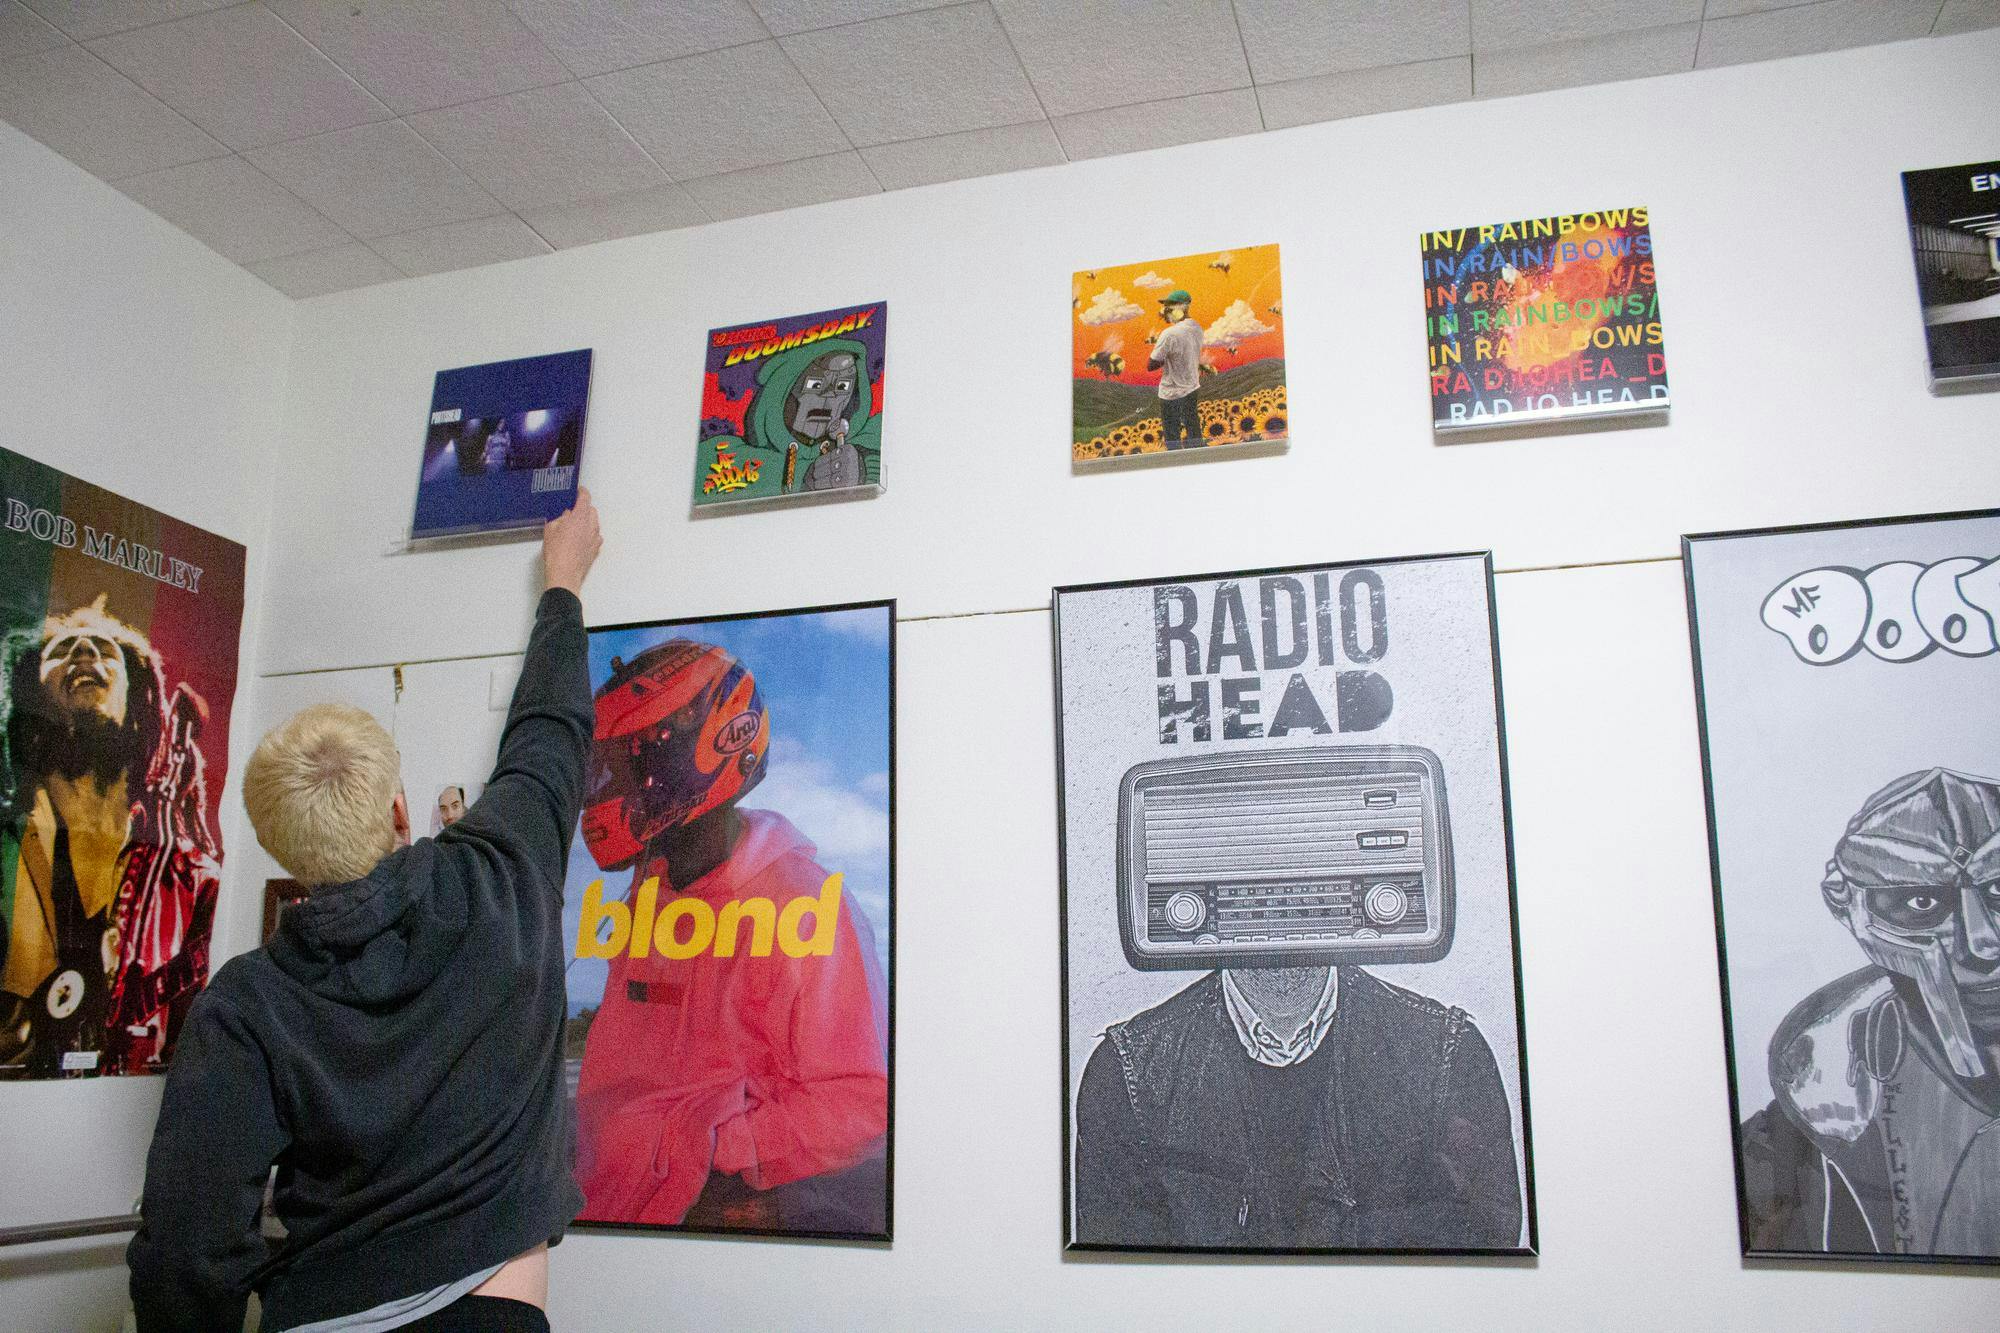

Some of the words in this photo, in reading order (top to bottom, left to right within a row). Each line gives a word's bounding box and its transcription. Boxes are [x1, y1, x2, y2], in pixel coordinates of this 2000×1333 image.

[1479, 207, 1650, 244] RAINBOWS
[1423, 256, 1456, 280] IN
[1425, 284, 1457, 308] IN
[1428, 315, 1459, 337] IN
[1430, 342, 1461, 365] IN
[5, 498, 77, 548] BOB
[82, 525, 204, 593] MARLEY
[1782, 584, 1821, 618] MF
[1153, 568, 1389, 677] RADIO
[1157, 670, 1394, 744] HEAD
[575, 872, 844, 960] blond
